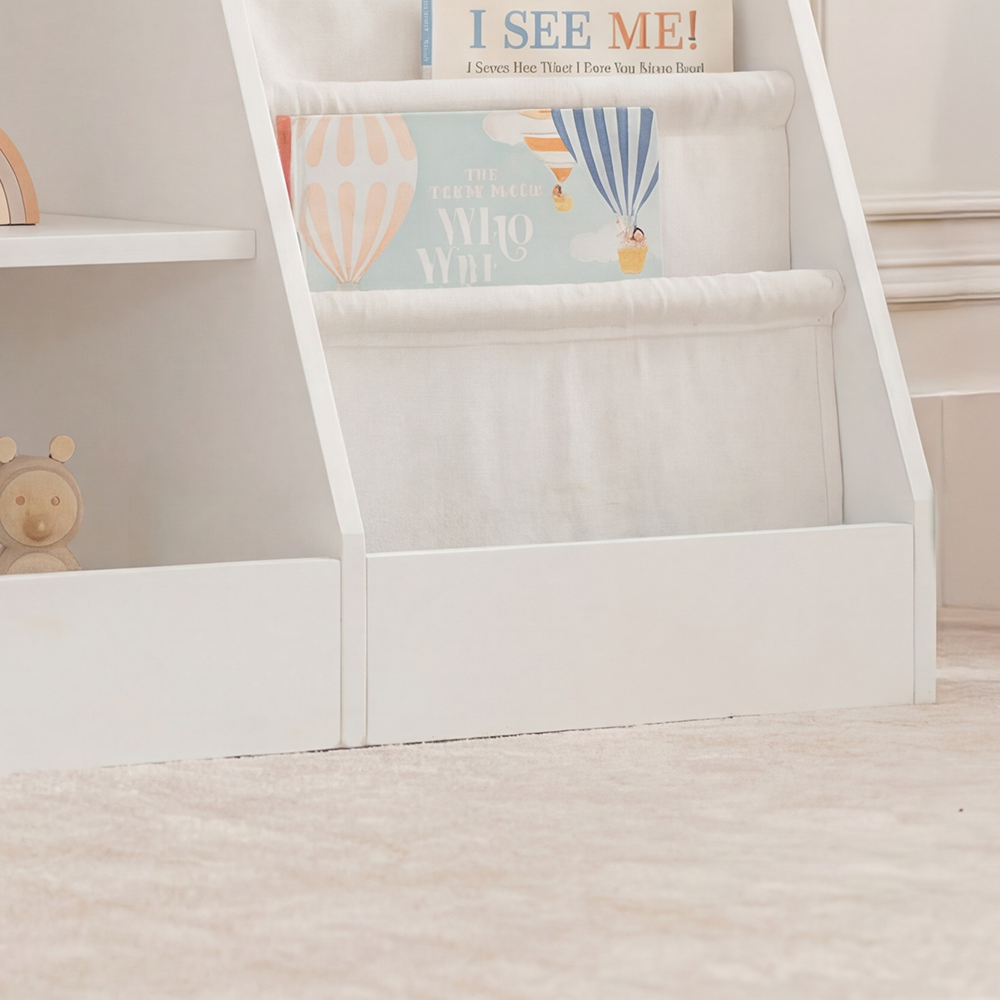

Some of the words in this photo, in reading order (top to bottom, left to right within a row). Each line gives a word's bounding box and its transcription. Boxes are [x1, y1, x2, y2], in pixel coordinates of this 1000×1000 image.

[469, 9, 486, 49] I
[504, 10, 591, 50] SEE
[607, 10, 697, 51] ME!
